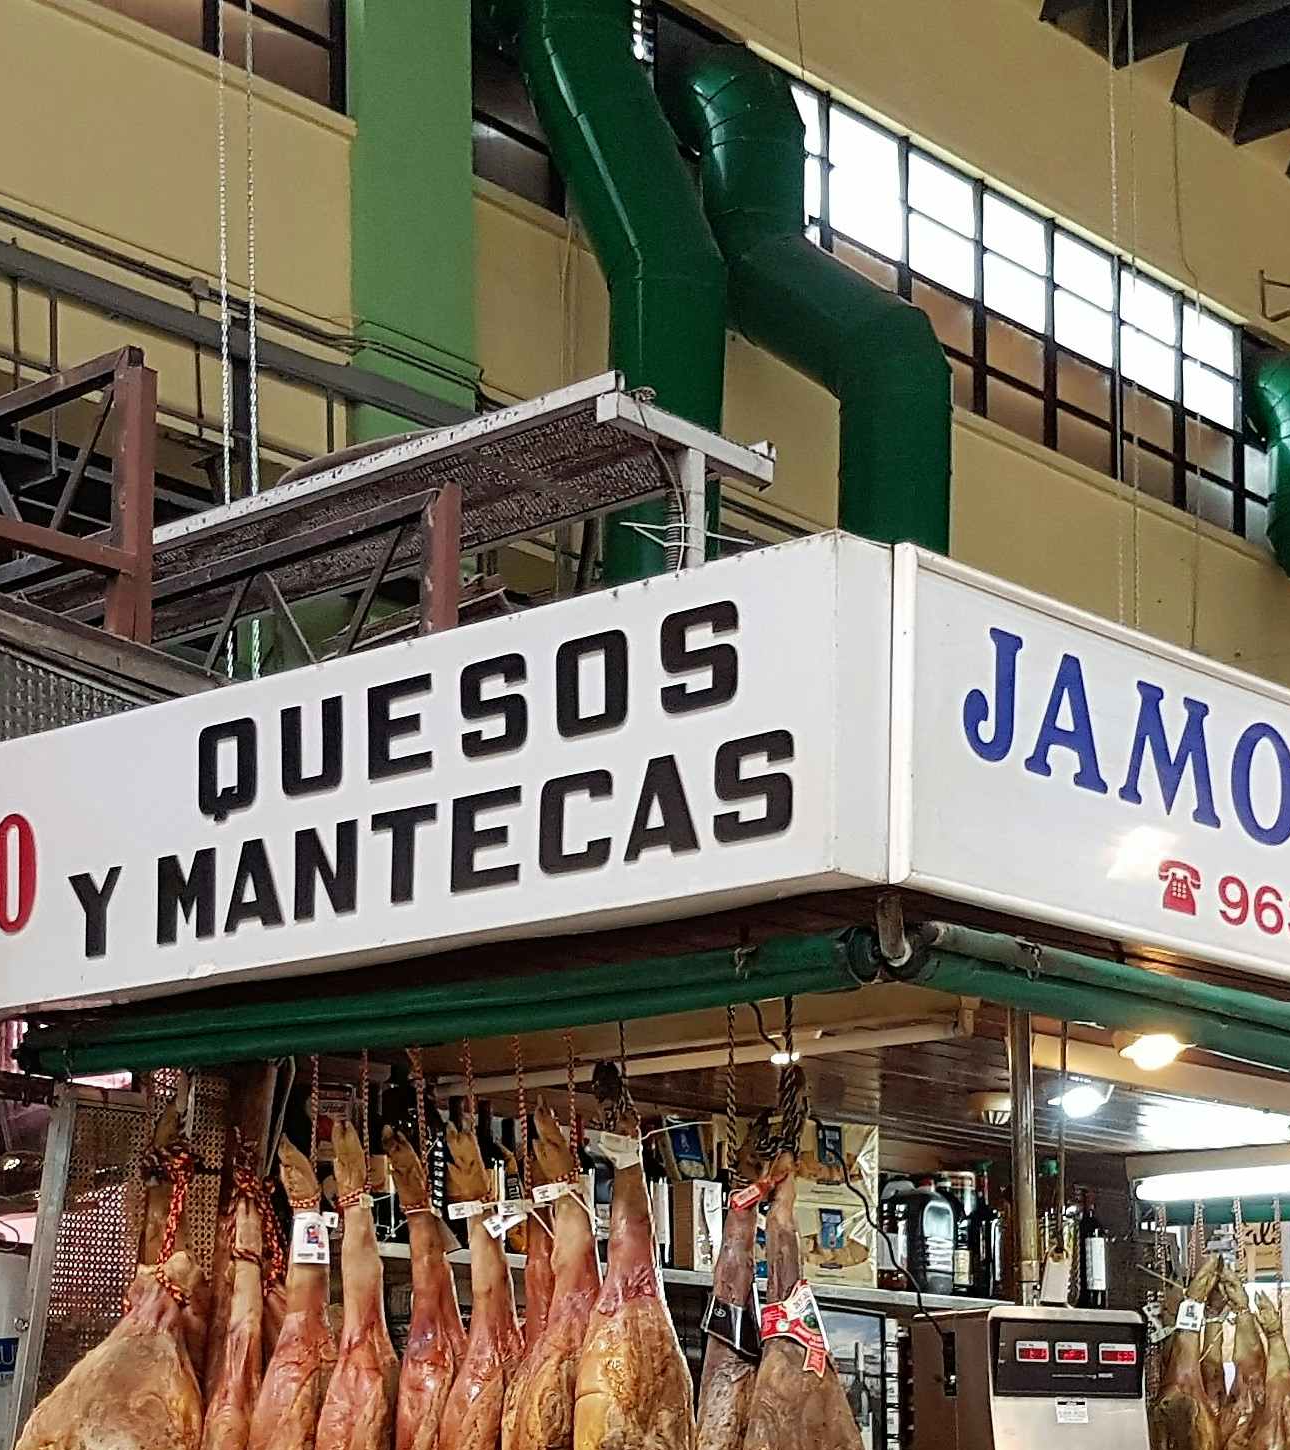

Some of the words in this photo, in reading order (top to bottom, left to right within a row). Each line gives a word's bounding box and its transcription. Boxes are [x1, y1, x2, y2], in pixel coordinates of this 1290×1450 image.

[198, 599, 740, 823] QUESOS
[68, 865, 123, 959] Y
[155, 727, 796, 948] MANTECAS
